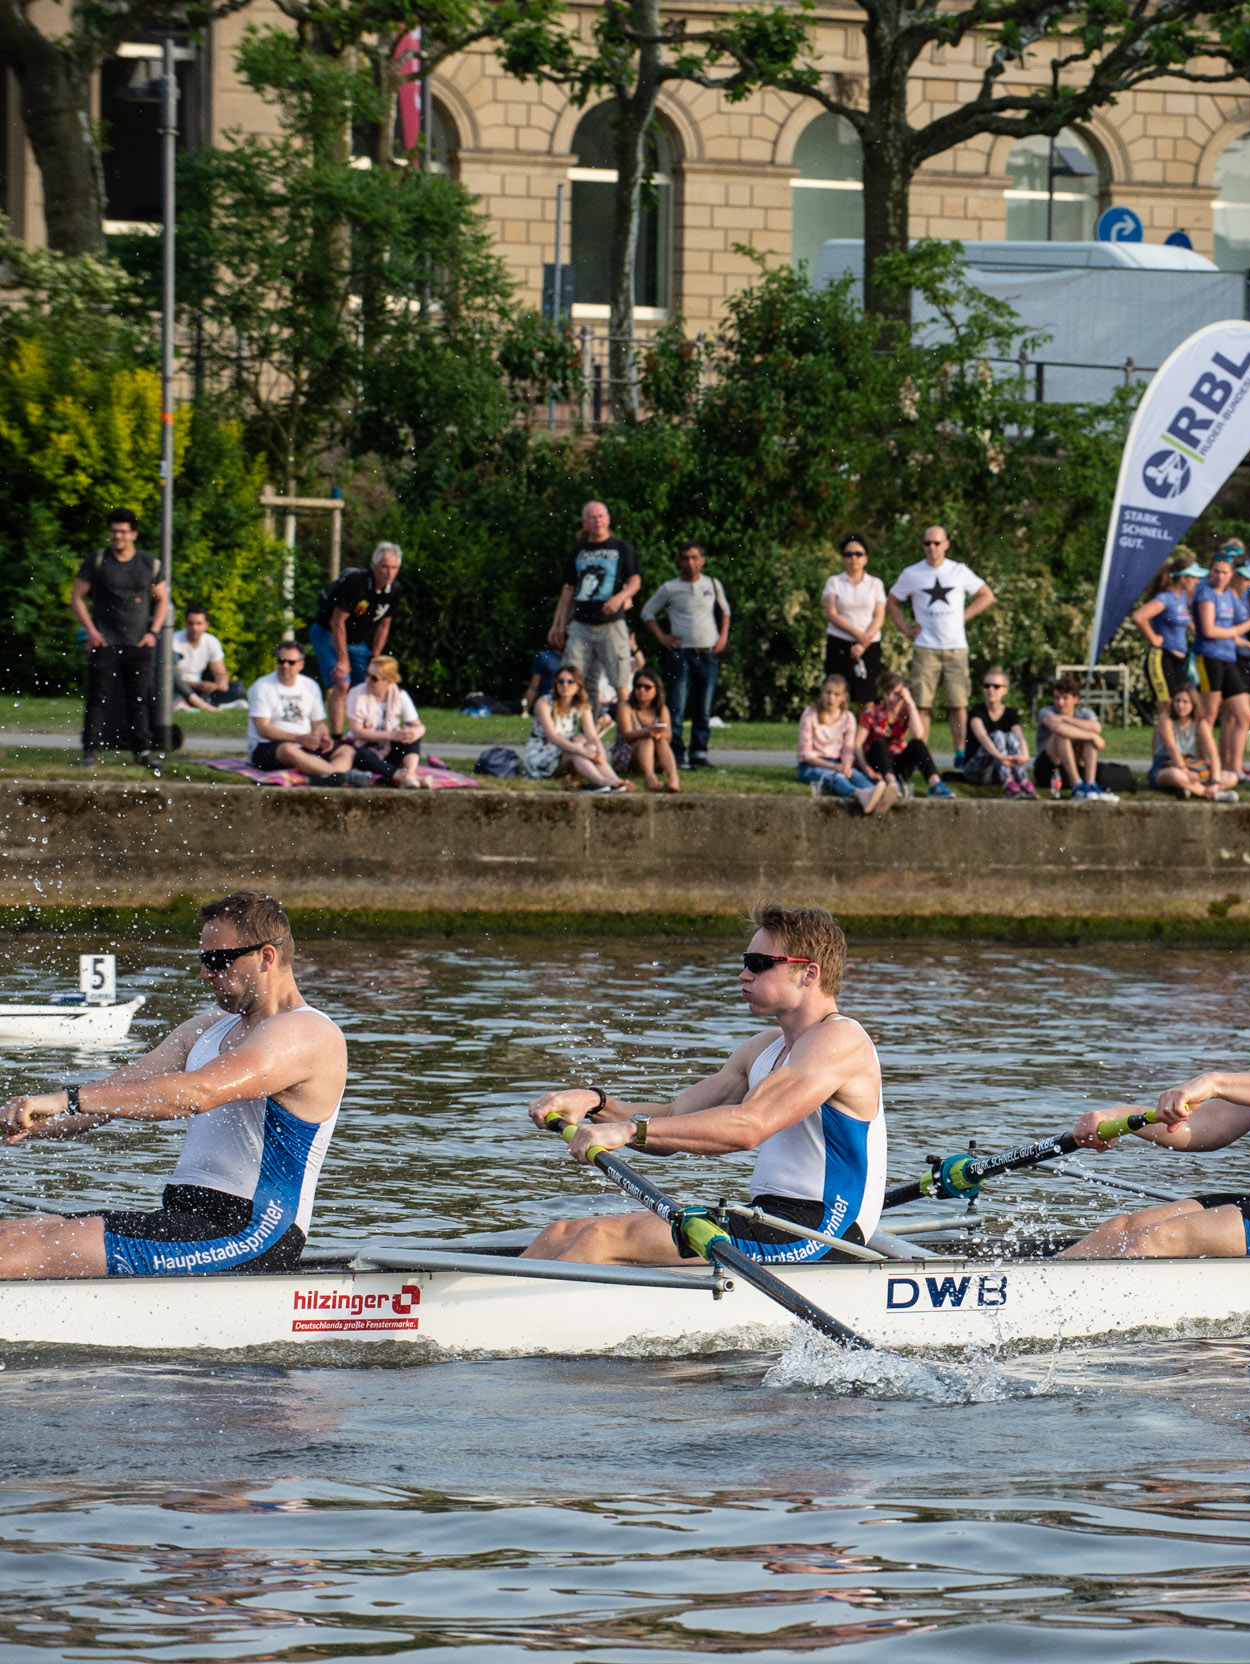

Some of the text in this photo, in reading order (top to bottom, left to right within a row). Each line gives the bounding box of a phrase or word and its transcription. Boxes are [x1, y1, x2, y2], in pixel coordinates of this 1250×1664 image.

[1123, 510, 1162, 526] STARK.
[1121, 522, 1174, 541] SCHNELL.
[1118, 536, 1145, 550] GUT.
[91, 958, 105, 990] 5
[152, 1199, 285, 1271] Hauptstadtsprinter
[293, 1290, 390, 1316] hilzinger
[886, 1276, 1008, 1310] DWB
[294, 1319, 417, 1331] Deutschlands große Fenstermarke.
